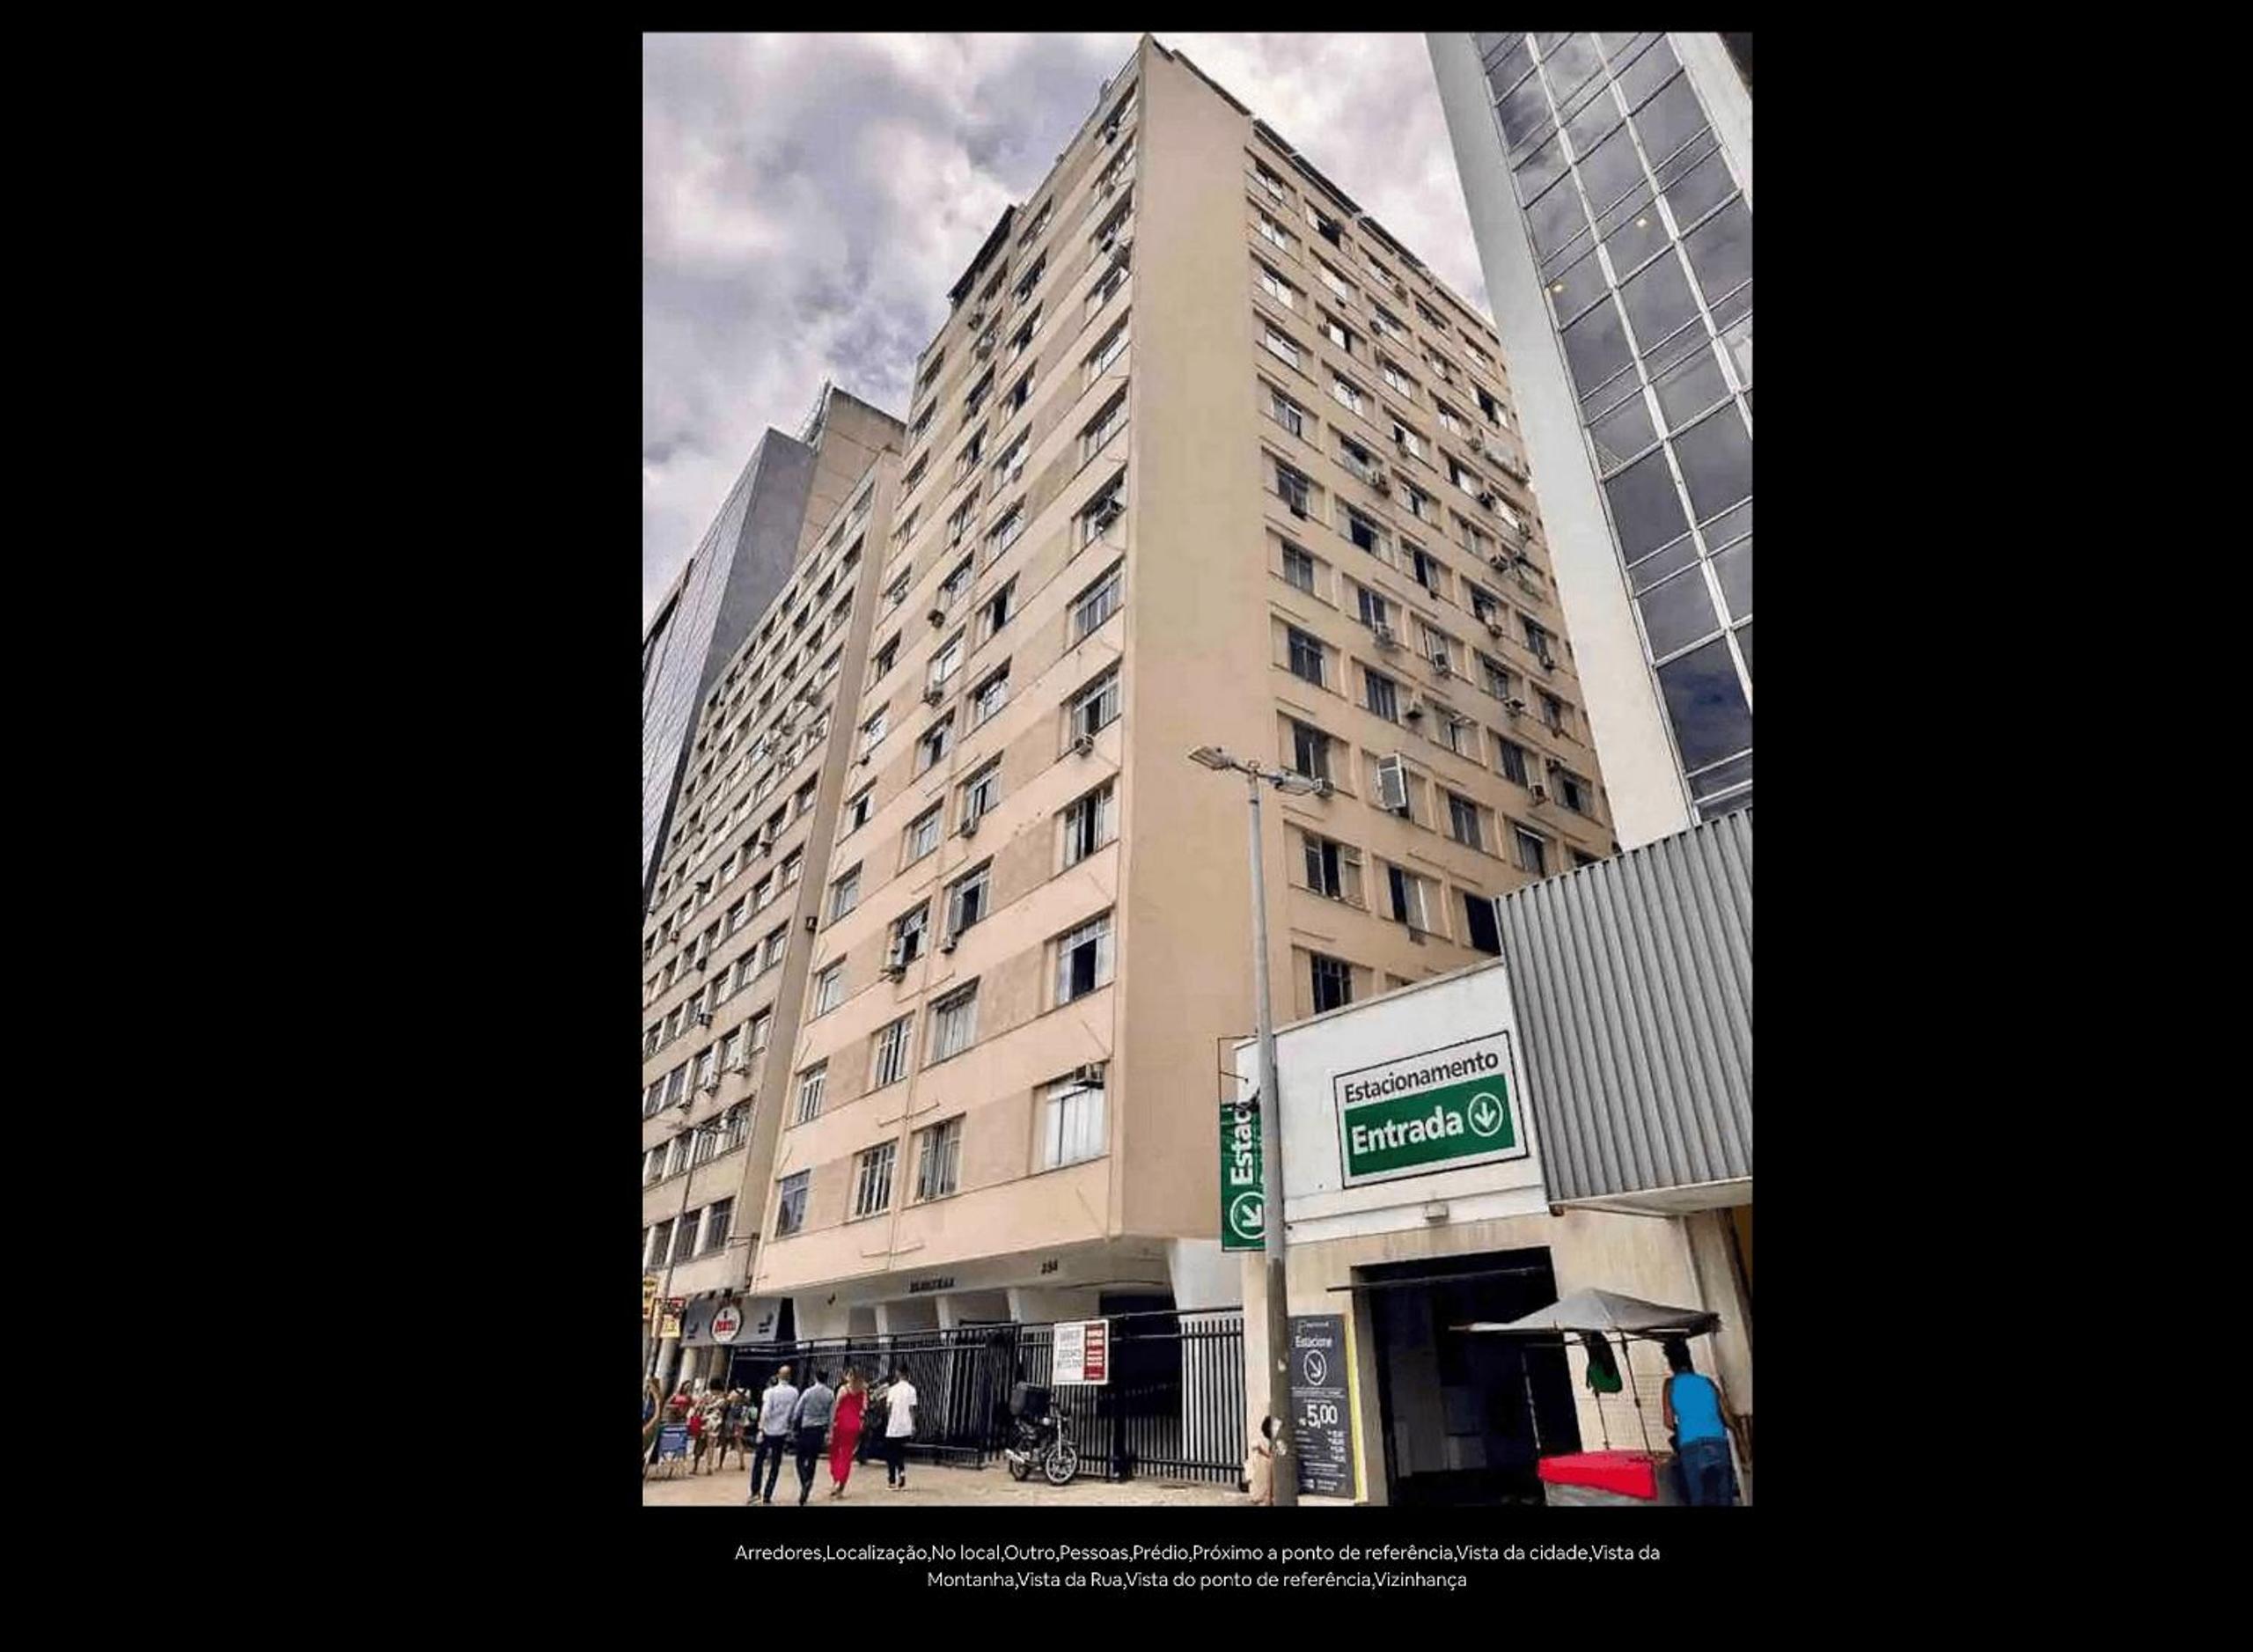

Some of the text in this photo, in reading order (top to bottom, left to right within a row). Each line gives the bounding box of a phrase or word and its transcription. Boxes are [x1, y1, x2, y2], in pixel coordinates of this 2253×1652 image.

[1345, 1051, 1500, 1104] Estacionamento
[1351, 1105, 1464, 1156] Entrada
[1307, 1405, 1338, 1429] 5,00
